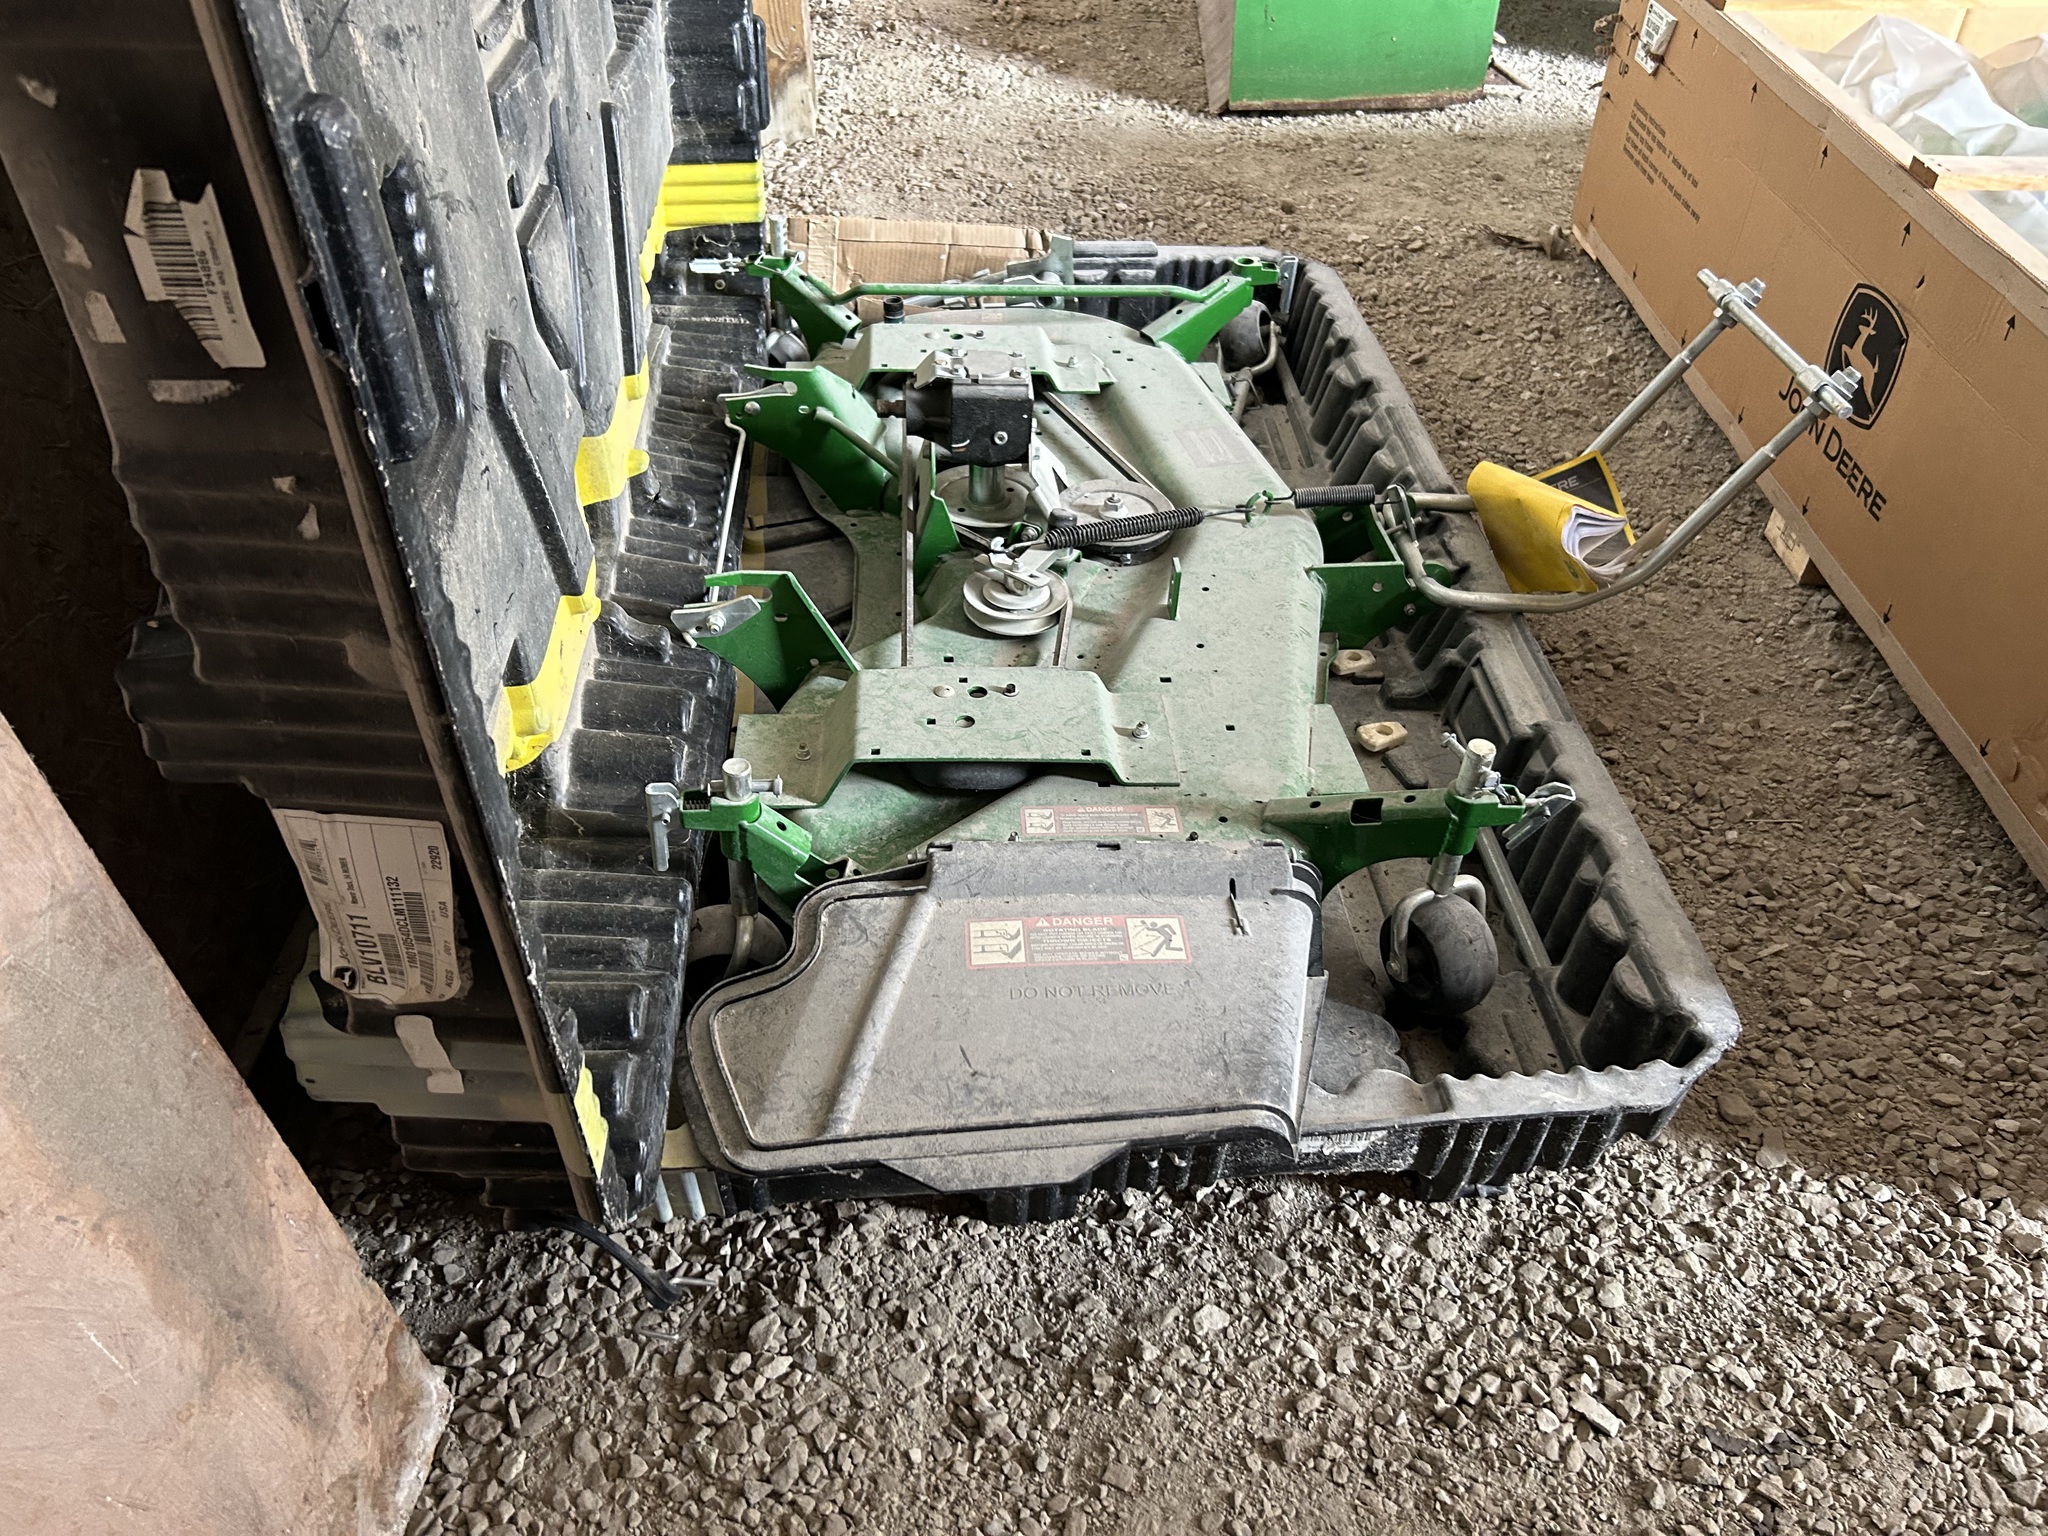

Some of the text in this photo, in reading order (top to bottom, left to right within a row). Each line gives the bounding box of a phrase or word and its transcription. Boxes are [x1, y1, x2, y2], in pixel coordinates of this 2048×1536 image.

[1619, 59, 1629, 78] UP
[1778, 376, 1887, 522] JON DEERE
[428, 845, 443, 870] 22920
[438, 901, 449, 918] USA
[1052, 917, 1114, 926] DANGER
[346, 914, 388, 985] BLV10711
[1010, 982, 1176, 1000] DO NOT REMOVE
